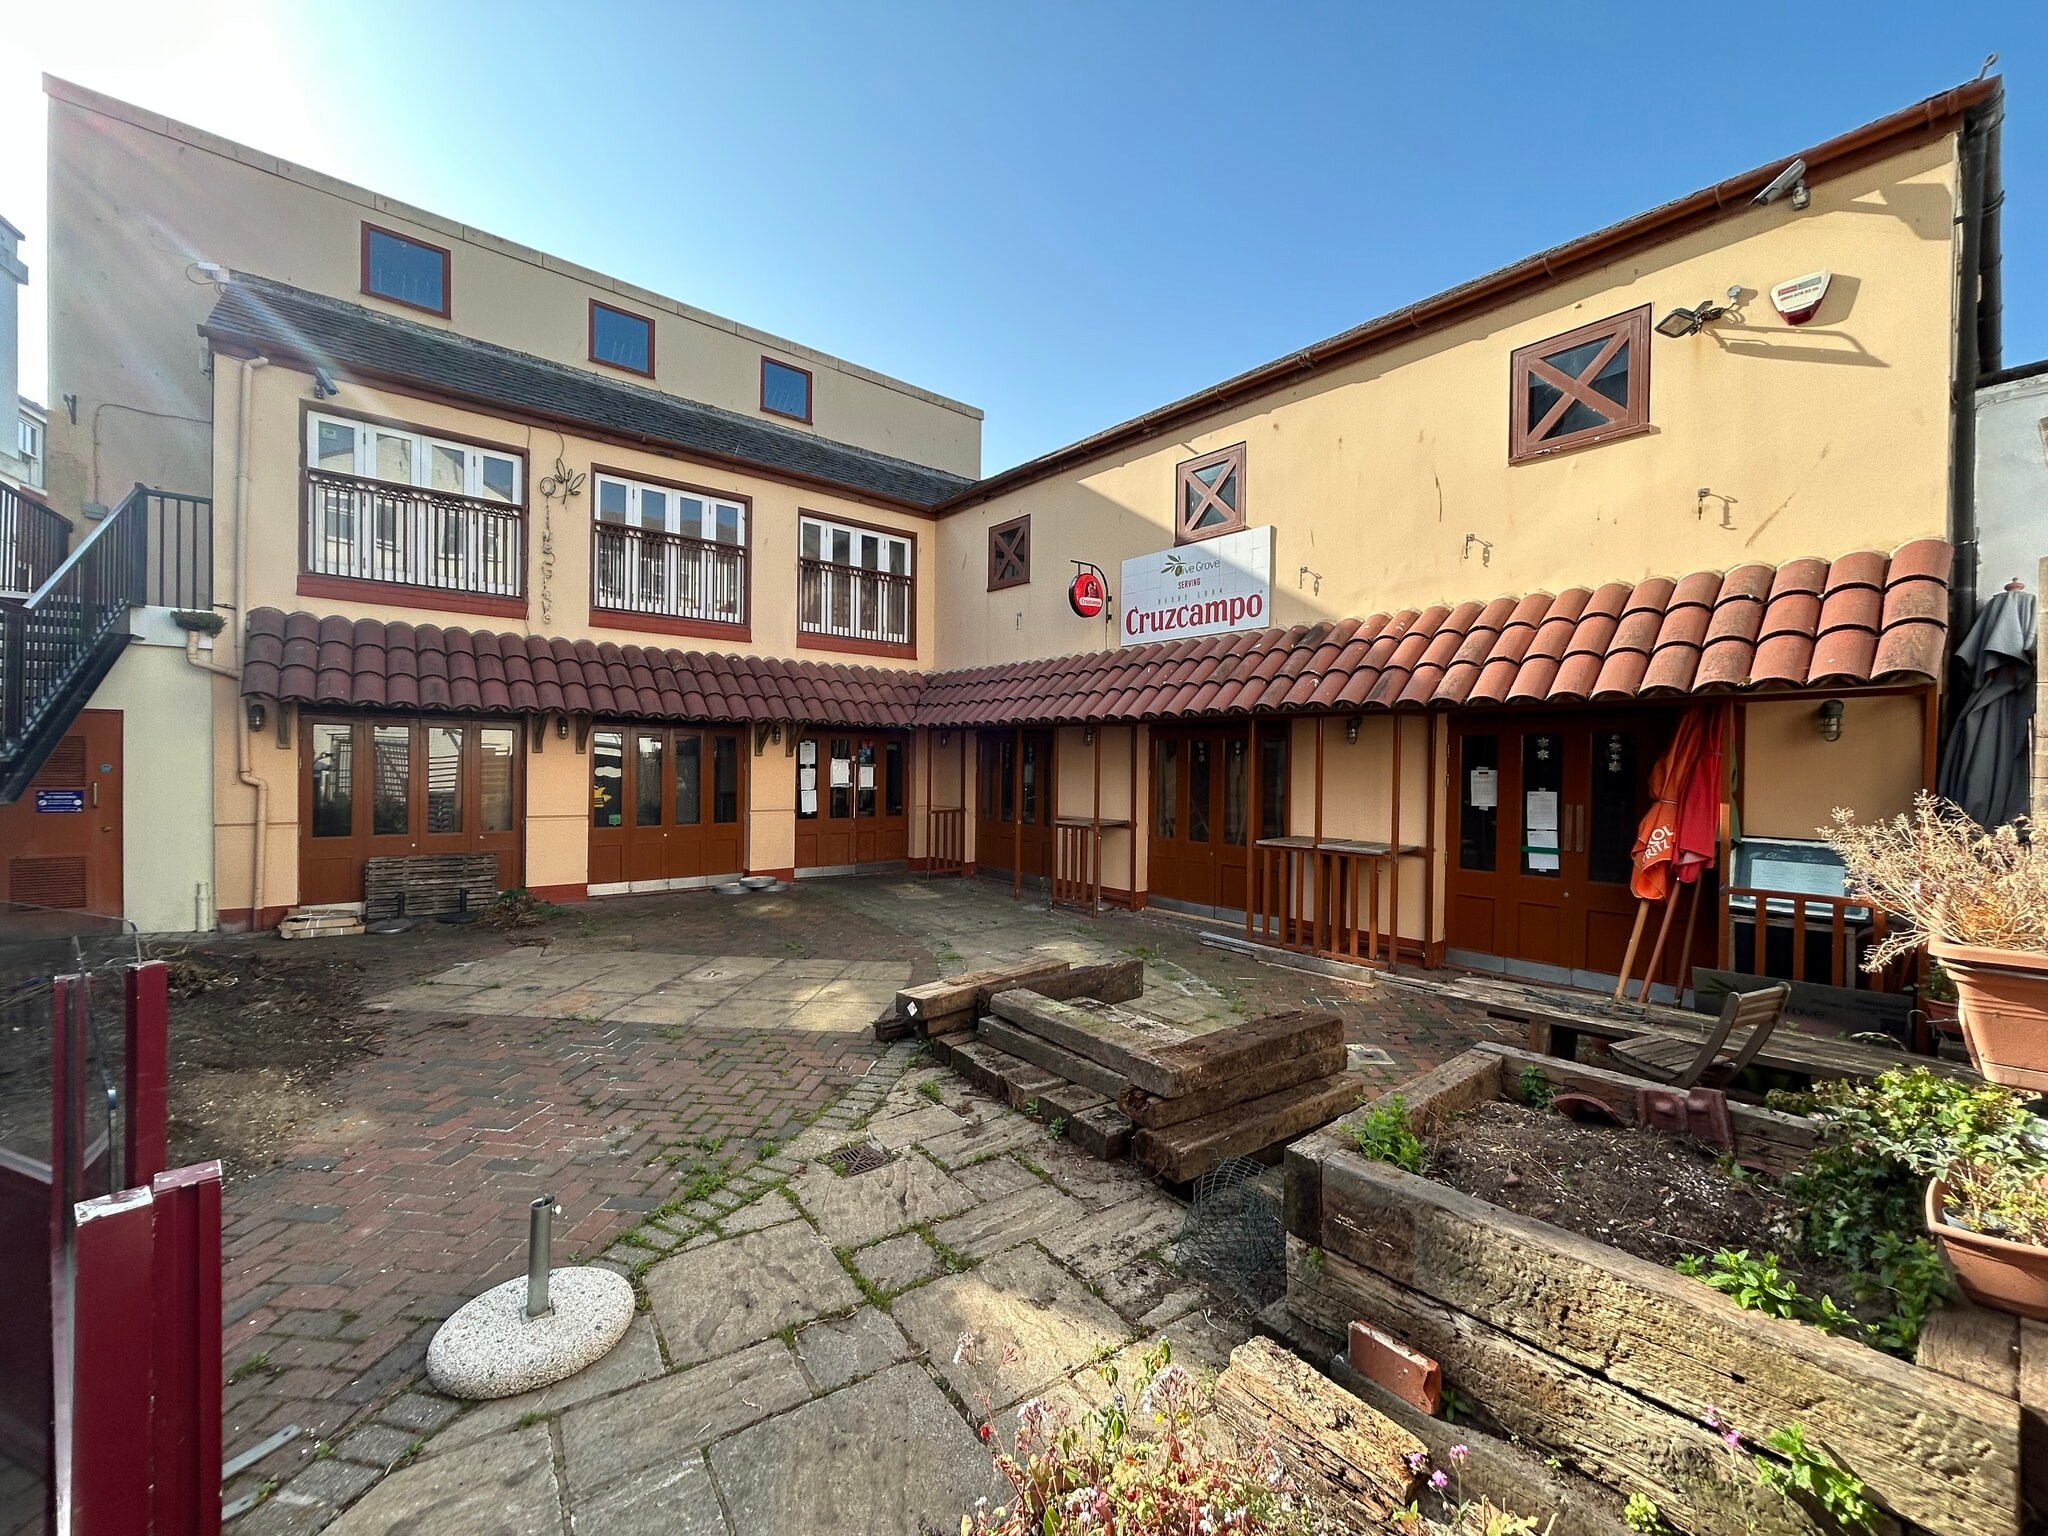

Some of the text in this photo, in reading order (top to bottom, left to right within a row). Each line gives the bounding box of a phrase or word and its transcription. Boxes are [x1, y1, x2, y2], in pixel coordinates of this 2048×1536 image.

[1196, 560, 1220, 572] Grove
[1178, 577, 1201, 589] SERVING
[1126, 594, 1263, 635] Cruzcampo
[1784, 1005, 1825, 1019] rove
